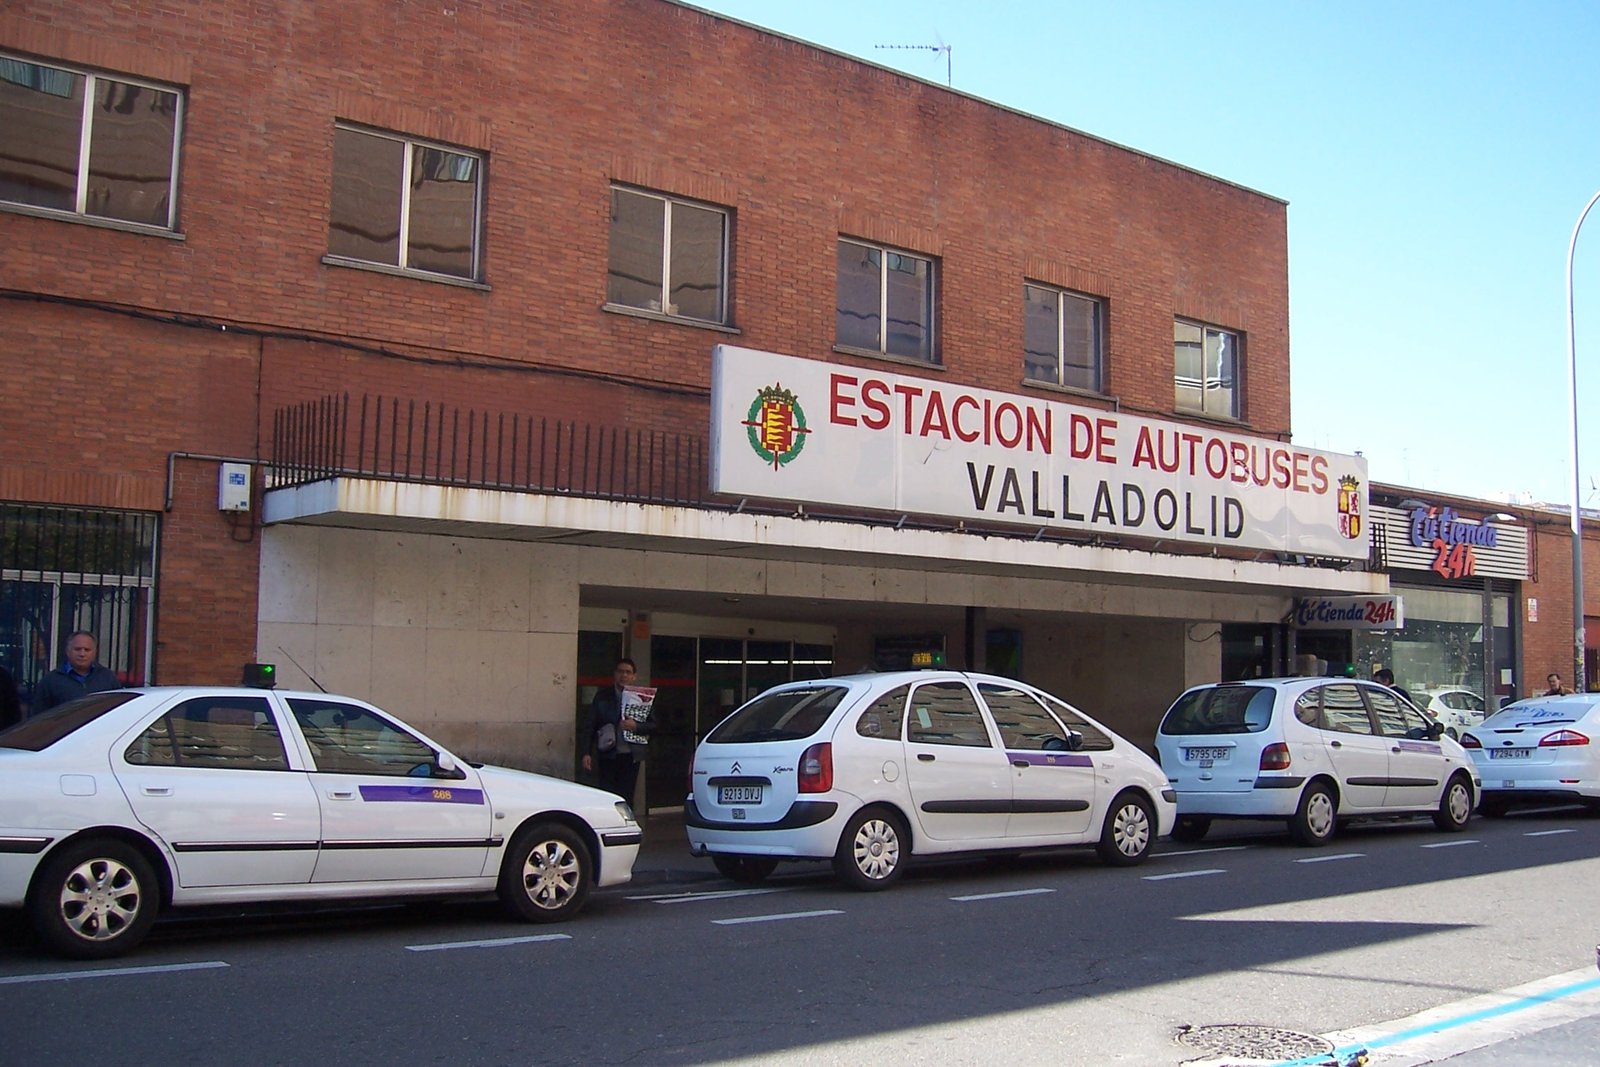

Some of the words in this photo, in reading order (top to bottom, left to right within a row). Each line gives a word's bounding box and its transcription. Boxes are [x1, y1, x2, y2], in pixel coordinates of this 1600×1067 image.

[829, 373, 1052, 455] ESTACION
[1070, 413, 1118, 465] DE
[1132, 425, 1329, 495] AUTOBUSES
[966, 461, 1245, 539] VALLADOLID
[1432, 538, 1476, 579] 24h
[1364, 600, 1395, 624] 24h
[1190, 748, 1210, 759] 5795
[724, 787, 742, 800] 9213
[744, 787, 760, 800] DVJ
